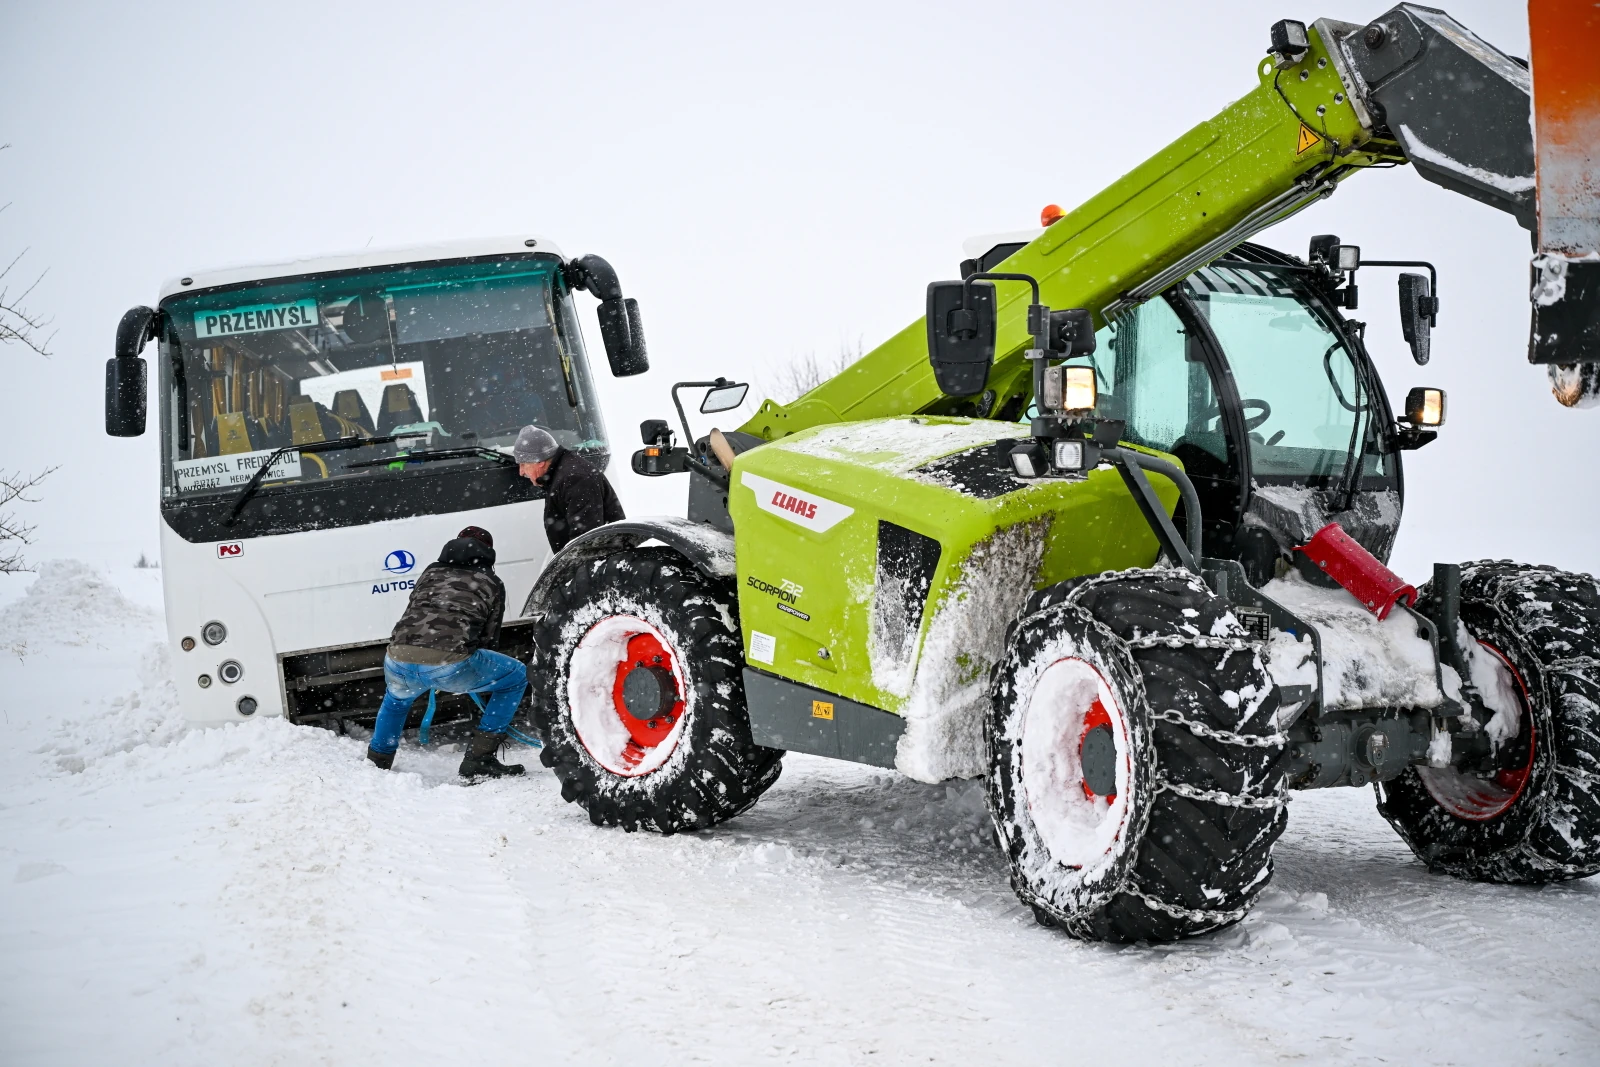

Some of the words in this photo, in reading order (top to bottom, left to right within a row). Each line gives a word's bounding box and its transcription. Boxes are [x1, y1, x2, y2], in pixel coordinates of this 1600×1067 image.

[771, 491, 818, 520] CLAAS
[371, 579, 415, 595] AUTOS
[747, 576, 797, 605] SCORPION
[779, 578, 804, 597] 732
